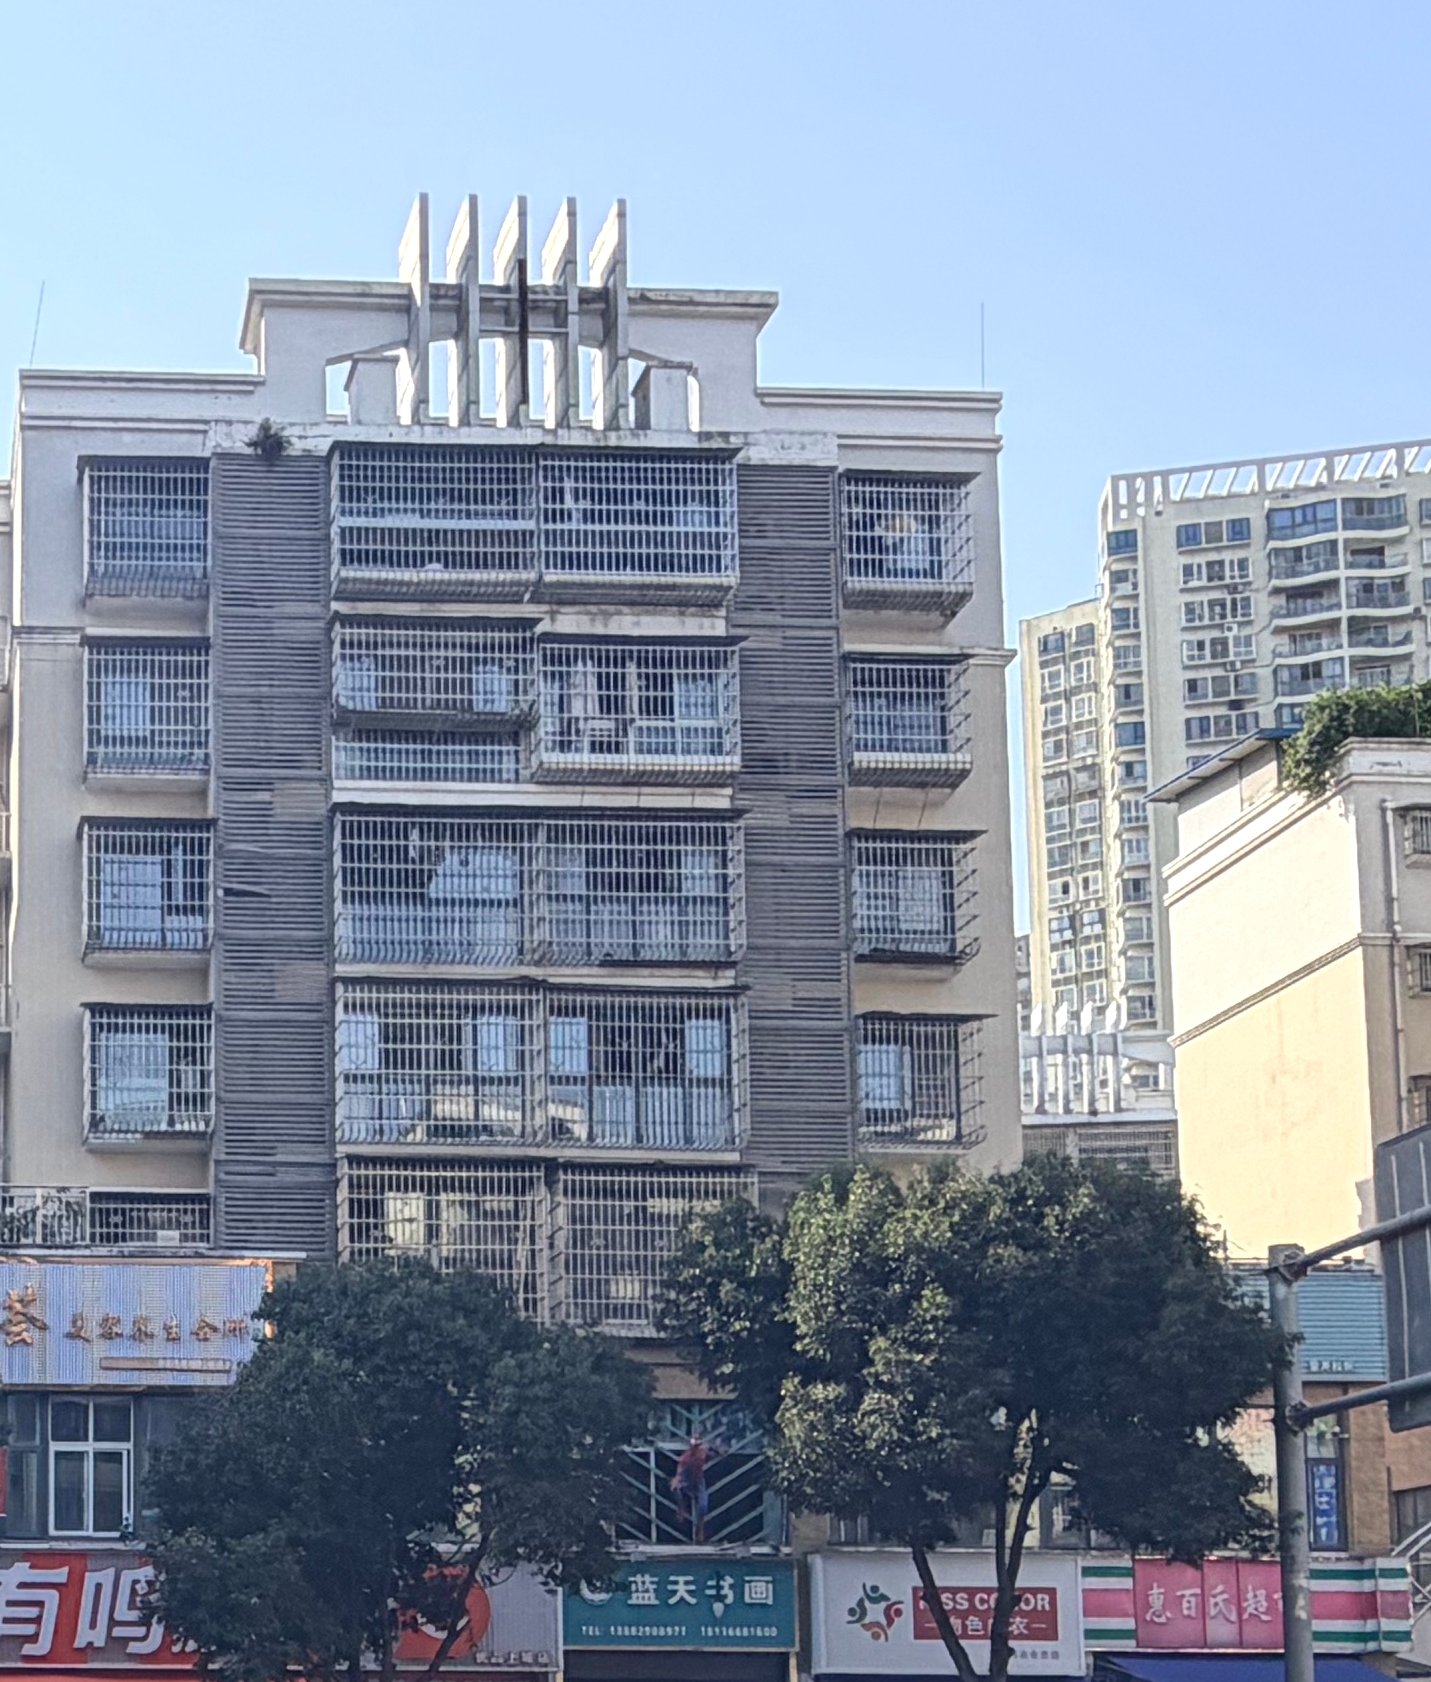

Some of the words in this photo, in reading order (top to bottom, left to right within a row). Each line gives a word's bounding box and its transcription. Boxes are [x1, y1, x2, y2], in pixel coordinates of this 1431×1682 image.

[626, 1573, 774, 1606] 蓝天书画
[918, 1592, 969, 1611] SS
[974, 1593, 1050, 1612] COR
